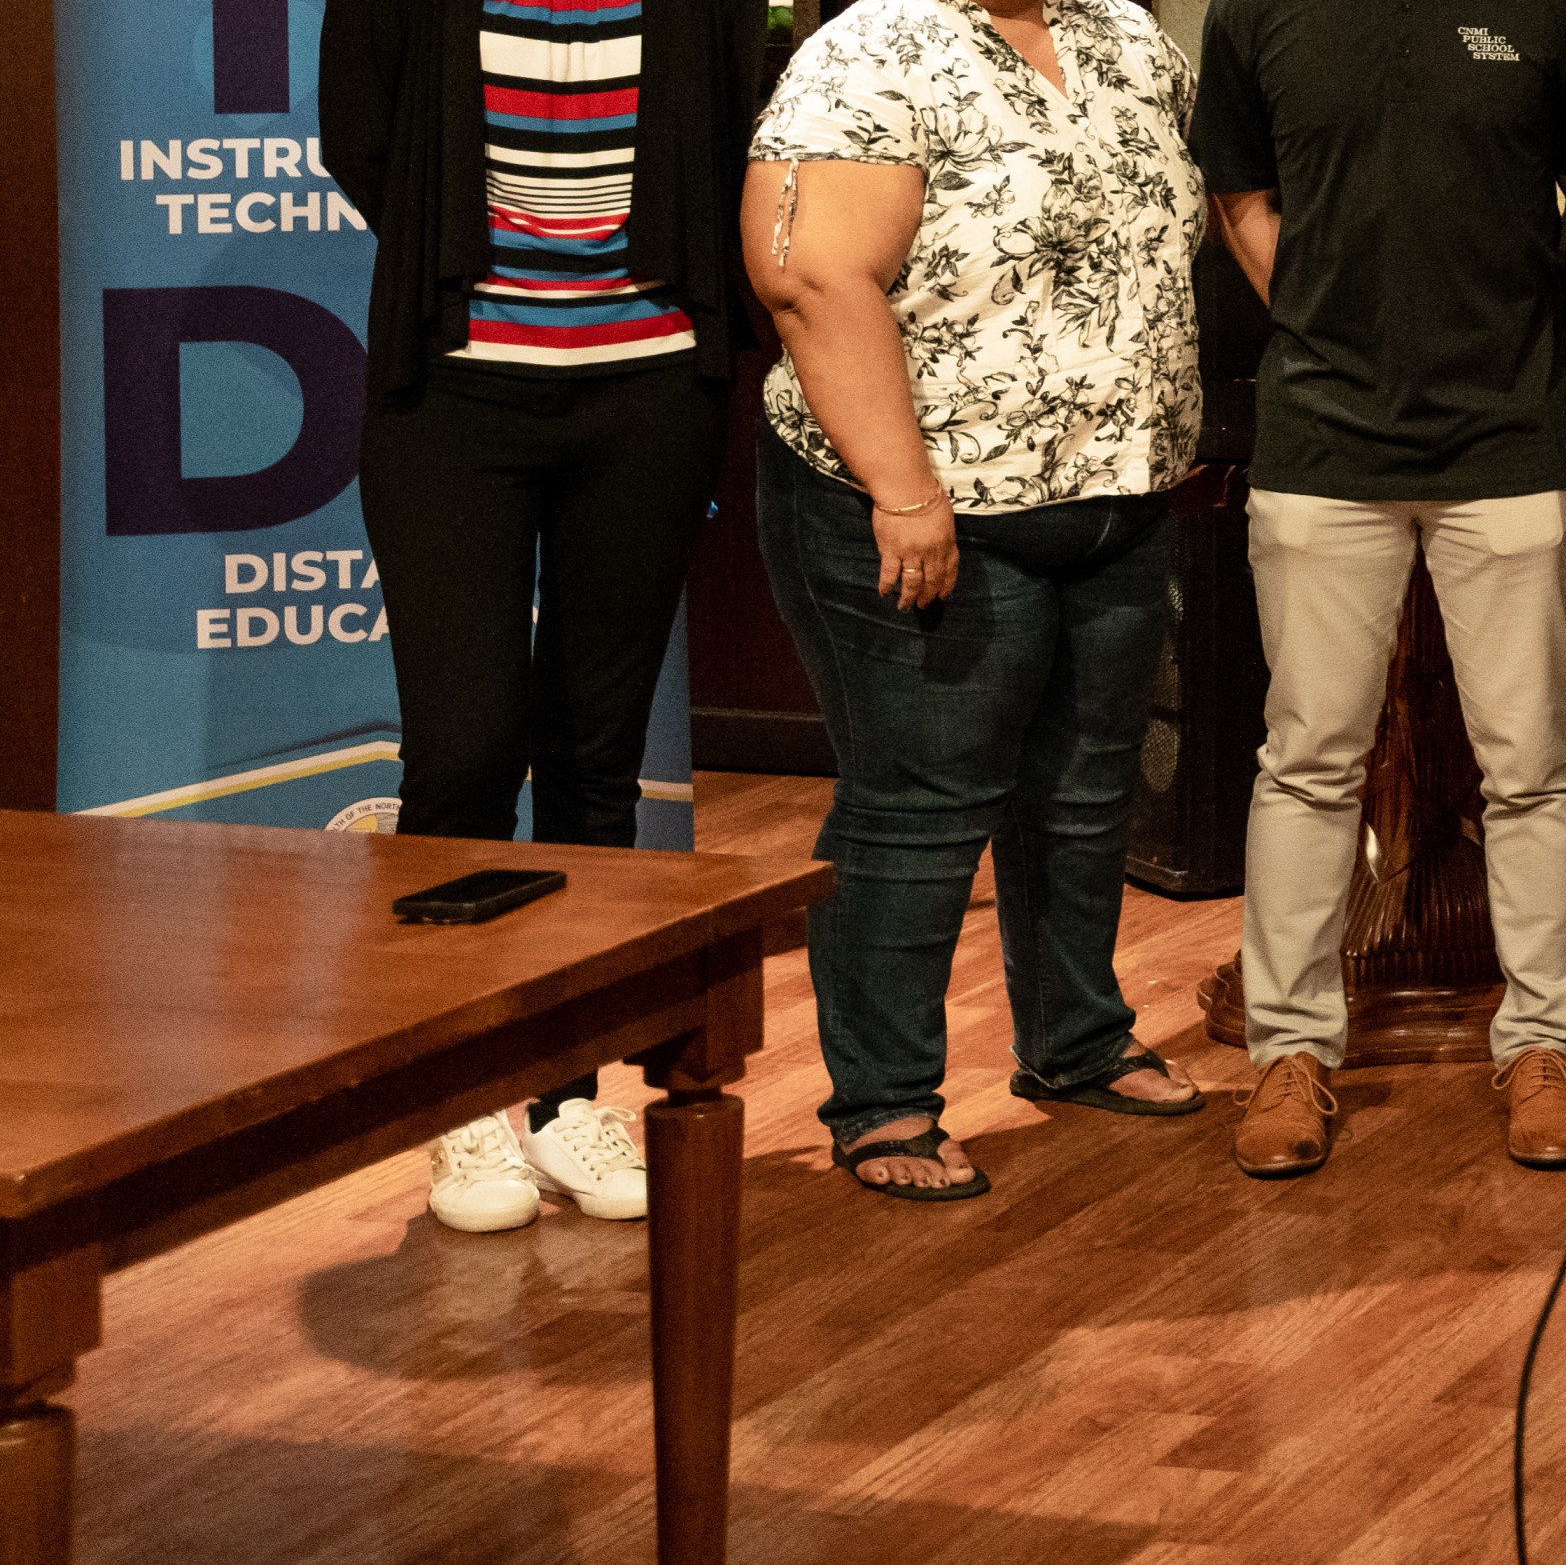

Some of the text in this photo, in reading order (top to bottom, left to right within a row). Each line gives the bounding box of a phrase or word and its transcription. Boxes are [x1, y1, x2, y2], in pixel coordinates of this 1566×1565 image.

[1458, 26, 1489, 35] CNMI
[1462, 35, 1507, 44] PUBLIC
[1467, 43, 1515, 53] SCHOOL
[1472, 52, 1520, 61] SYSTEM
[357, 804, 373, 814] THE
